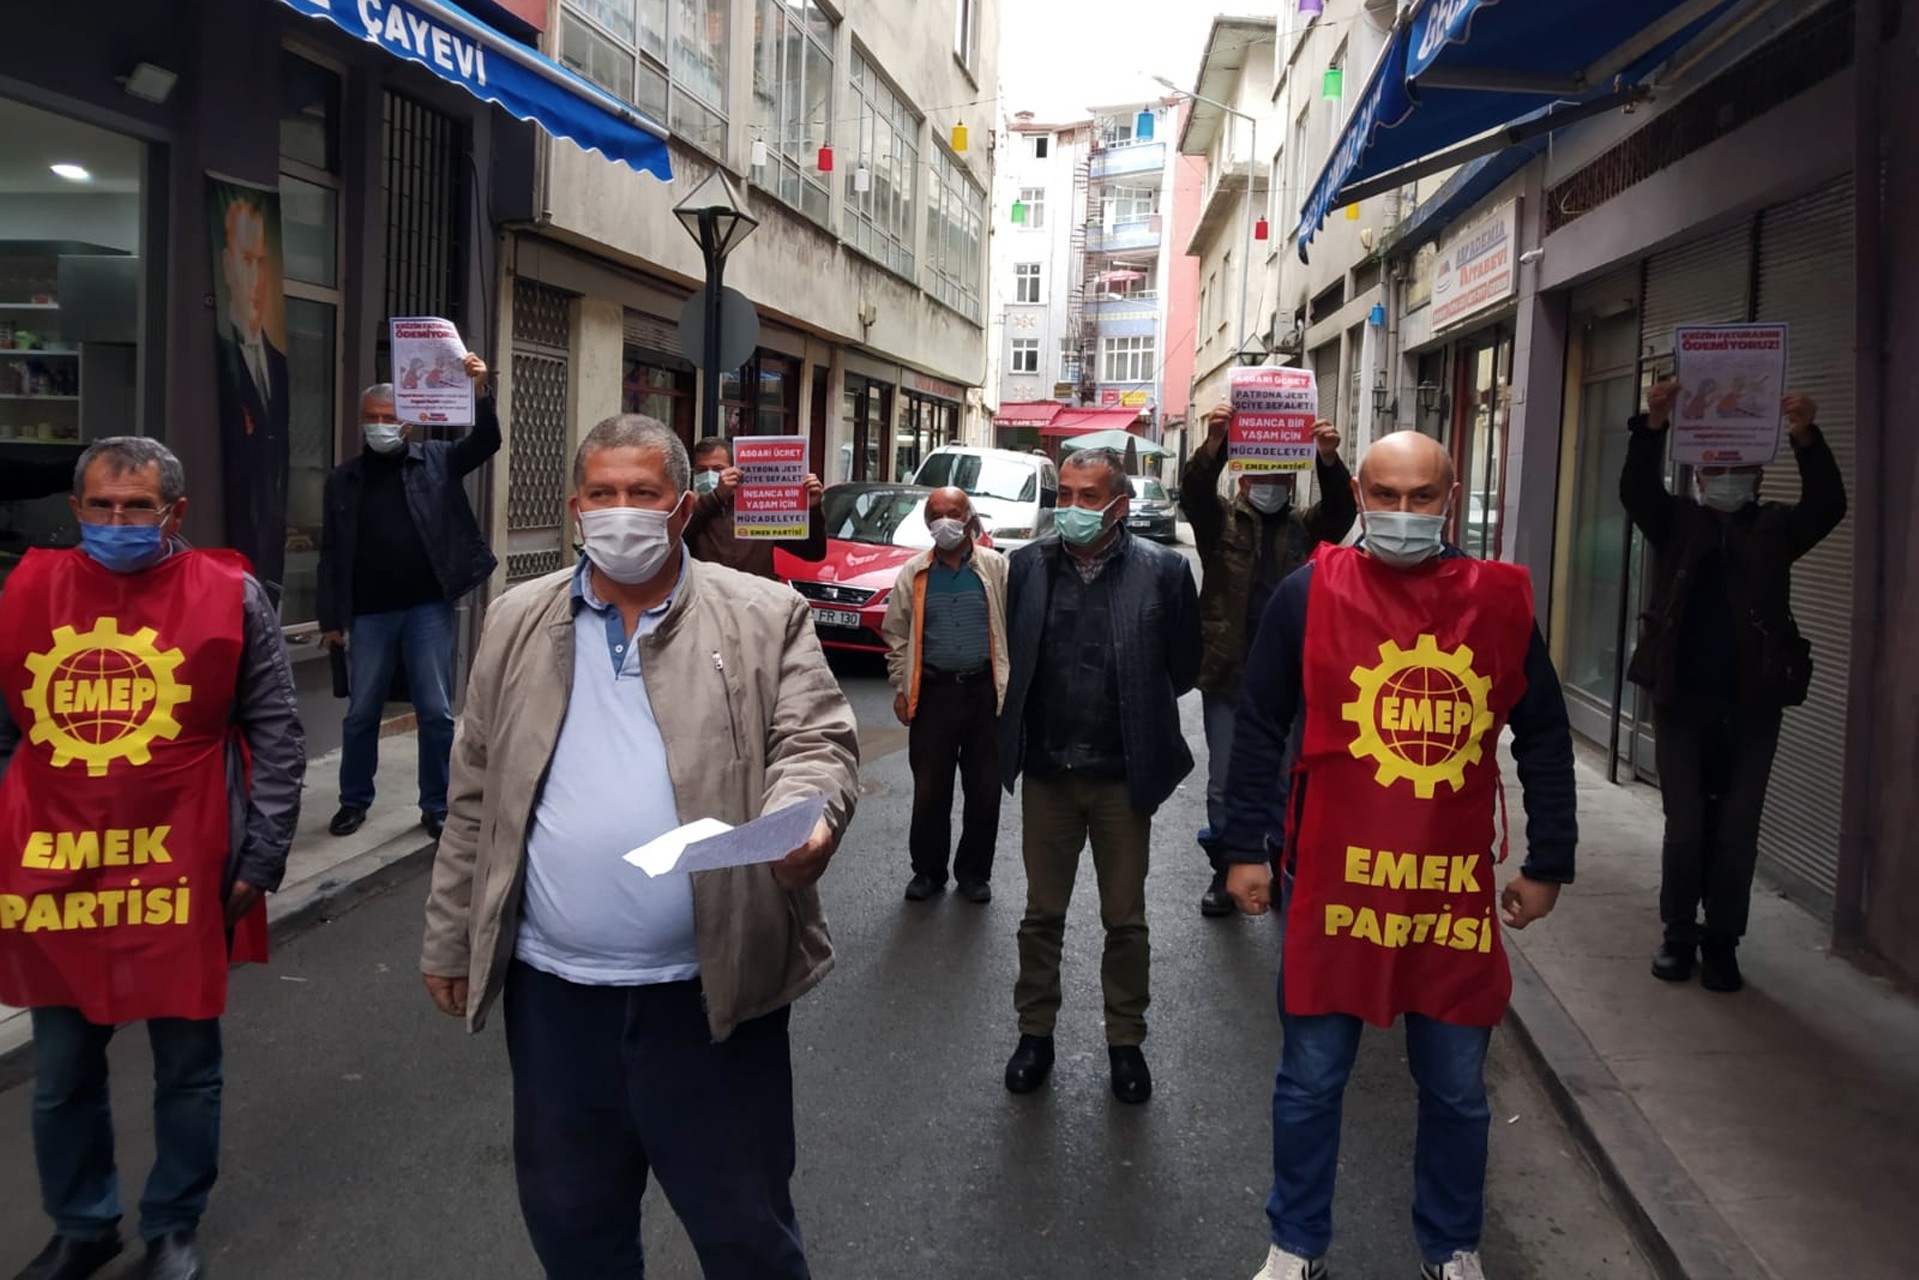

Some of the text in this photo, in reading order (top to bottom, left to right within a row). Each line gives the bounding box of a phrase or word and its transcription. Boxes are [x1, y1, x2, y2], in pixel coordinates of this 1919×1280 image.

[357, 0, 487, 86] ÇAYEVİ
[1236, 391, 1282, 399] PATRONA
[1238, 416, 1305, 427] İNSANCA BİR
[1241, 429, 1302, 441] YAŞAM İÇİN
[773, 447, 801, 457] ÜCRET
[1230, 445, 1311, 456] MÜCADELEYE!
[743, 488, 783, 498] İNSANCA
[746, 500, 778, 509] YAŞAM
[819, 610, 858, 624] FR 130
[53, 678, 155, 714] EMEP
[1381, 697, 1473, 735] EMEP
[21, 825, 173, 870] EMEK
[1344, 846, 1481, 893] EMEK
[0, 876, 190, 932] PARTİSİ
[1324, 903, 1493, 953] PARTİSİ
